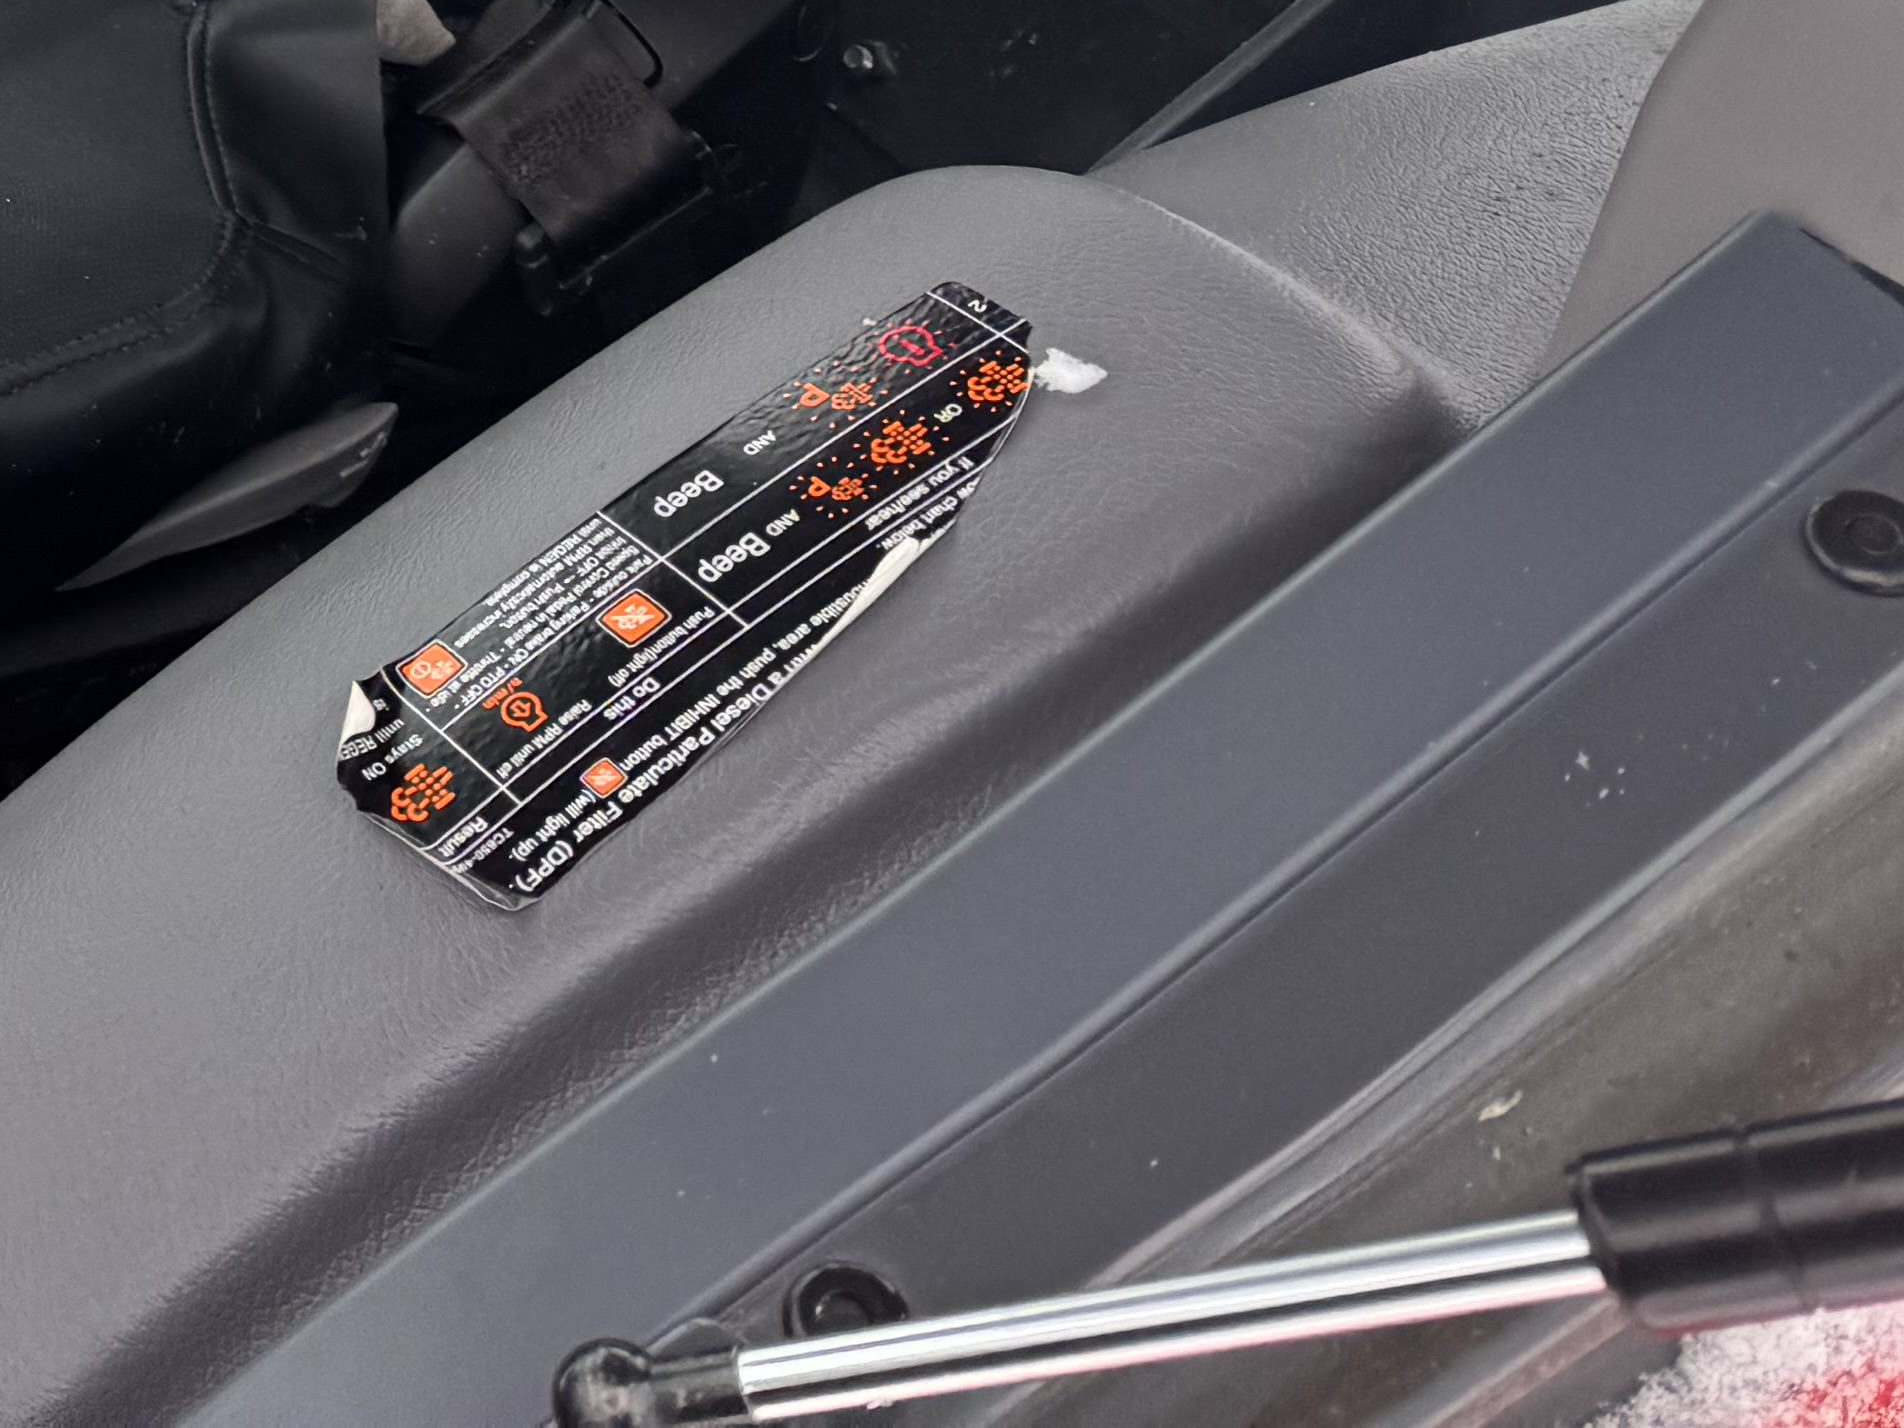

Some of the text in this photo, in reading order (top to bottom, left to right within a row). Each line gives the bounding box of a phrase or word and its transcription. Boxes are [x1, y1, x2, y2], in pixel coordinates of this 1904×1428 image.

[653, 430, 775, 517] AND Beep
[697, 403, 962, 582] OR AND Beep
[865, 455, 974, 529] If you see/hear
[881, 519, 925, 553] below.
[682, 606, 715, 629] Push
[771, 623, 811, 650] area,
[738, 647, 775, 678] push
[767, 671, 788, 688] a
[603, 676, 660, 719] Do this
[715, 675, 743, 696] the
[558, 699, 591, 725] Raise
[664, 693, 720, 740] INHIBIT
[710, 683, 772, 731] Diesel
[374, 718, 404, 743] until
[532, 722, 561, 749] RPM
[361, 733, 423, 780] Stays ON
[509, 743, 535, 767] until
[618, 727, 713, 802] Particulate
[619, 734, 665, 770] button
[566, 788, 596, 818] (will
[438, 816, 487, 856] Result
[535, 812, 570, 842] light
[573, 800, 622, 842] Filter
[508, 840, 573, 891] (DPF).
